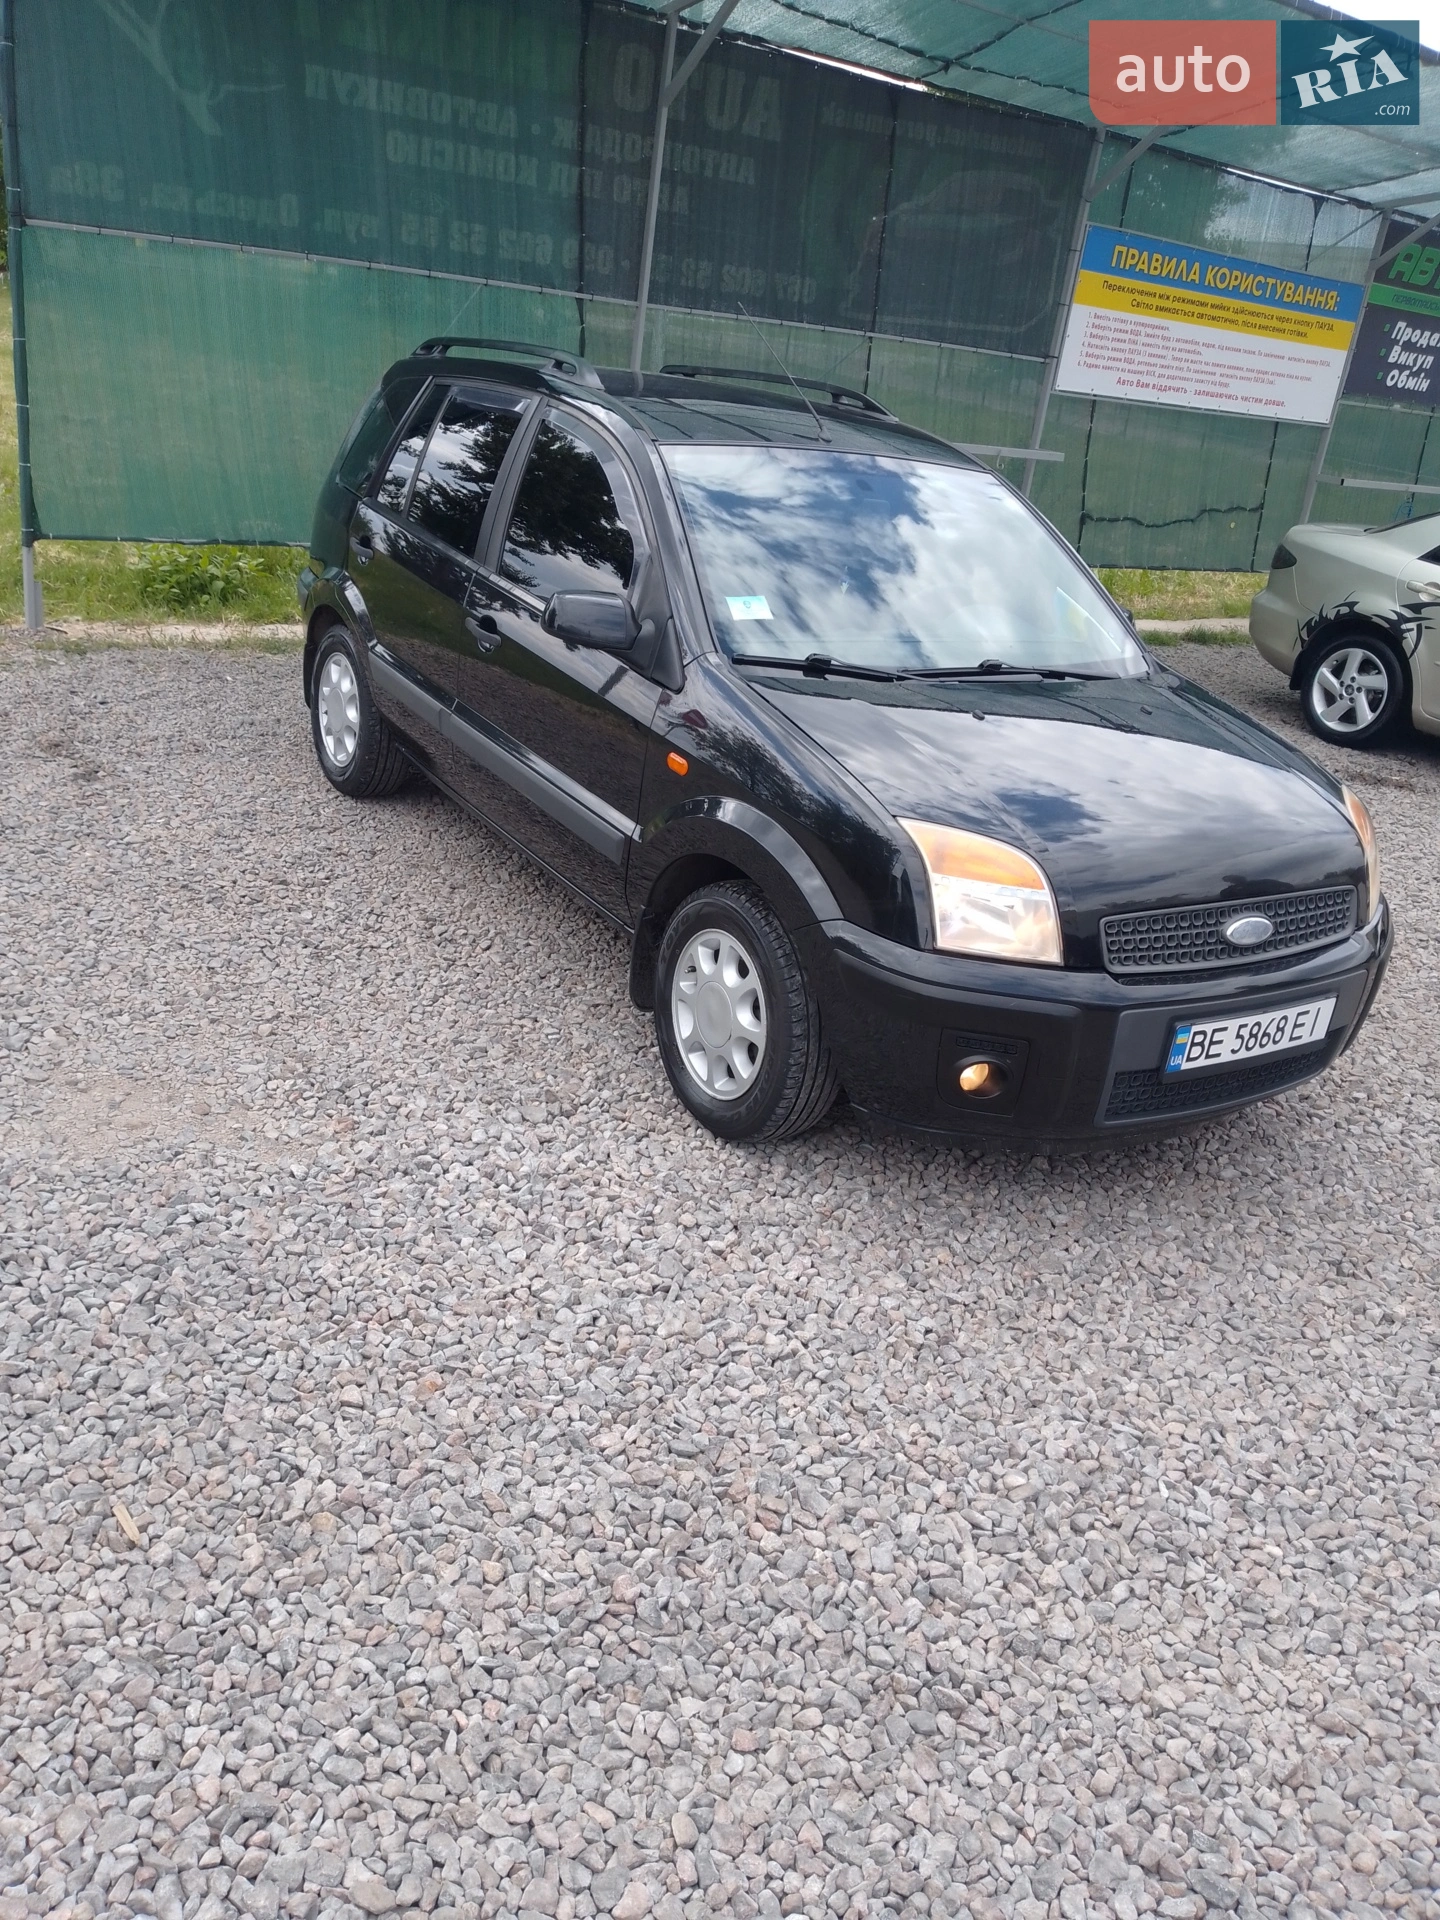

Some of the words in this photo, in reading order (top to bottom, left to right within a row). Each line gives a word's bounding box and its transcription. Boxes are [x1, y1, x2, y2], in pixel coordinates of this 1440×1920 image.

[1111, 245, 1200, 284] ПРАВИЛА
[1204, 265, 1340, 311] КОРИСТУВАННЯ:
[1388, 243, 1440, 289] АВ
[1102, 280, 1157, 300] Переключення
[1158, 291, 1171, 303] між
[1172, 294, 1209, 310] режимами
[1210, 301, 1231, 313] мийки
[1232, 304, 1275, 322] здійснюються
[1275, 313, 1293, 326] через
[1294, 317, 1315, 330] кнопку
[1315, 320, 1335, 333] ПАУЗА.
[1131, 299, 1154, 312] Світло
[1155, 305, 1195, 319] вмикається
[1196, 311, 1241, 327] автоматично,
[1241, 318, 1257, 329] після
[1258, 323, 1287, 334] внесення
[1287, 326, 1308, 338] готівки.
[1388, 345, 1434, 372] Викуп
[1116, 376, 1134, 387] Авто
[1135, 378, 1152, 389] Вам
[1152, 381, 1188, 395] віддячить
[1193, 388, 1239, 401] залишаючись
[1240, 395, 1264, 404] чистим
[1386, 369, 1430, 392] Обмін
[1170, 1056, 1182, 1066] UA
[1185, 1026, 1229, 1063] BE
[1231, 1015, 1288, 1055] 5868
[1288, 1007, 1321, 1042] EI
